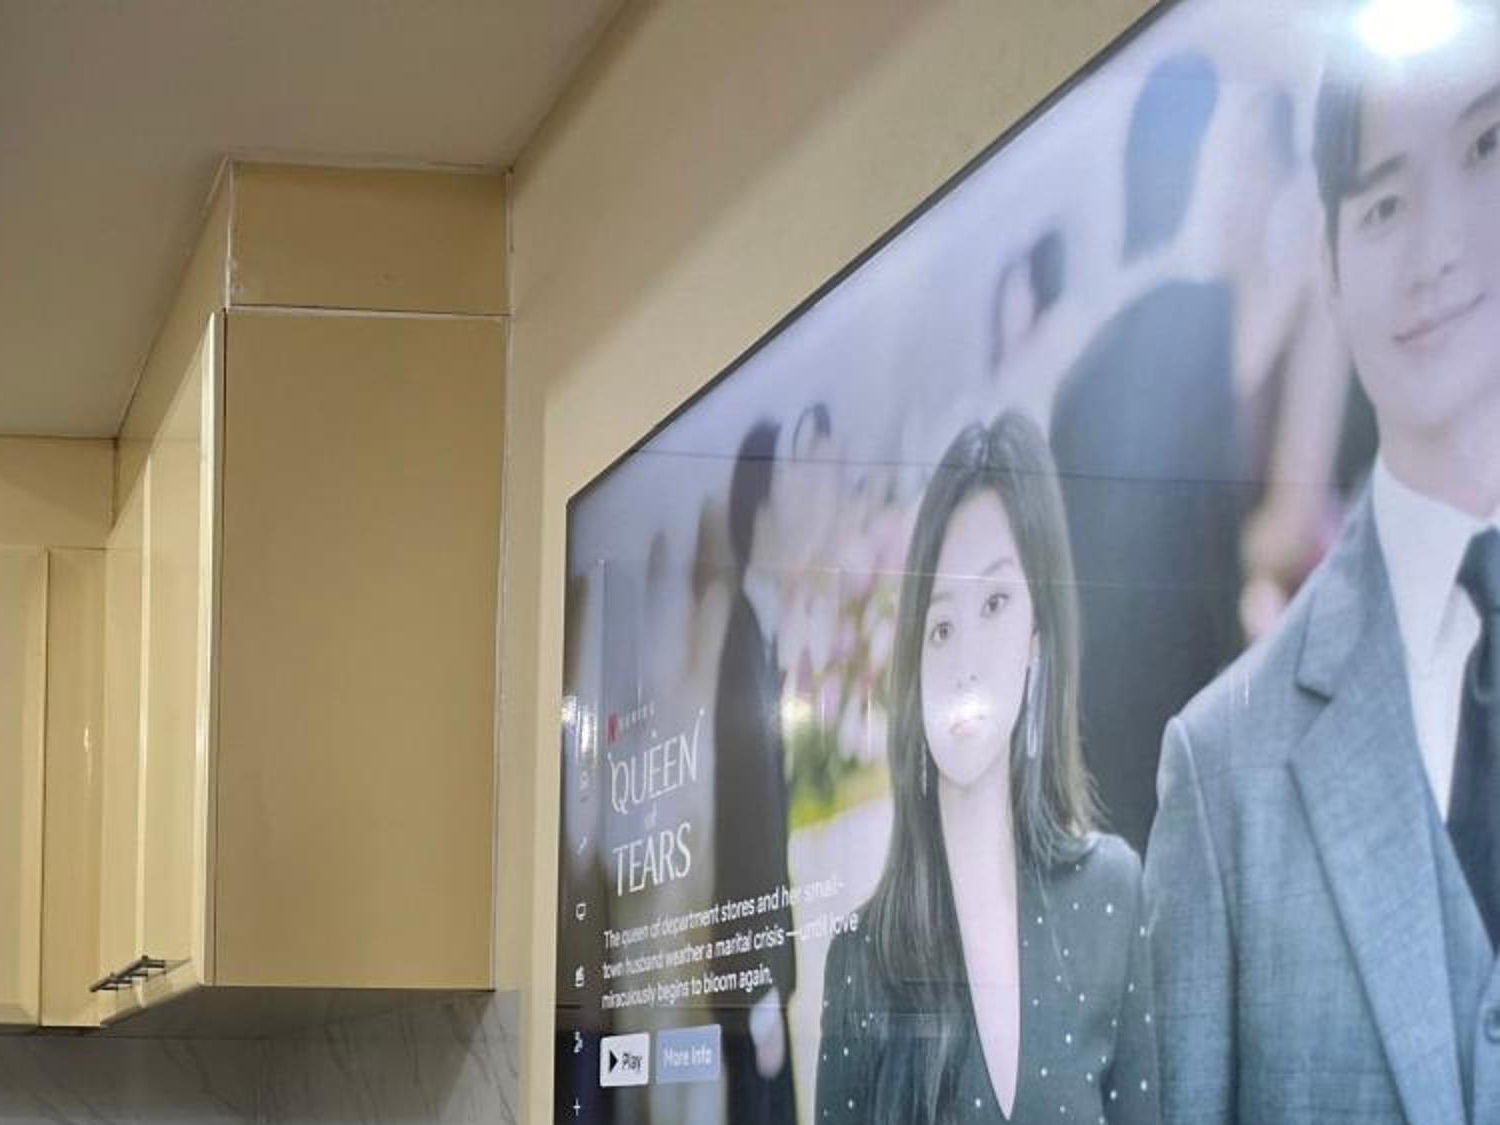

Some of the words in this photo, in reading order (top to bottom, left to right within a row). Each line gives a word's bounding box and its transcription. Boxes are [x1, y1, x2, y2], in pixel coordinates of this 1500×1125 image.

[608, 722, 704, 815] QUEEN
[612, 821, 691, 896] TEARS
[603, 929, 620, 950] The
[621, 924, 649, 948] queen
[661, 903, 719, 939] department
[721, 898, 755, 922] stores
[757, 884, 780, 914] and
[714, 929, 752, 958] marital
[753, 923, 785, 951] crisis
[829, 909, 859, 936] love
[703, 970, 738, 995] bloom
[739, 962, 773, 993] again.
[621, 1051, 644, 1075] Play
[662, 1046, 689, 1069] More
[690, 1043, 713, 1066] Info
